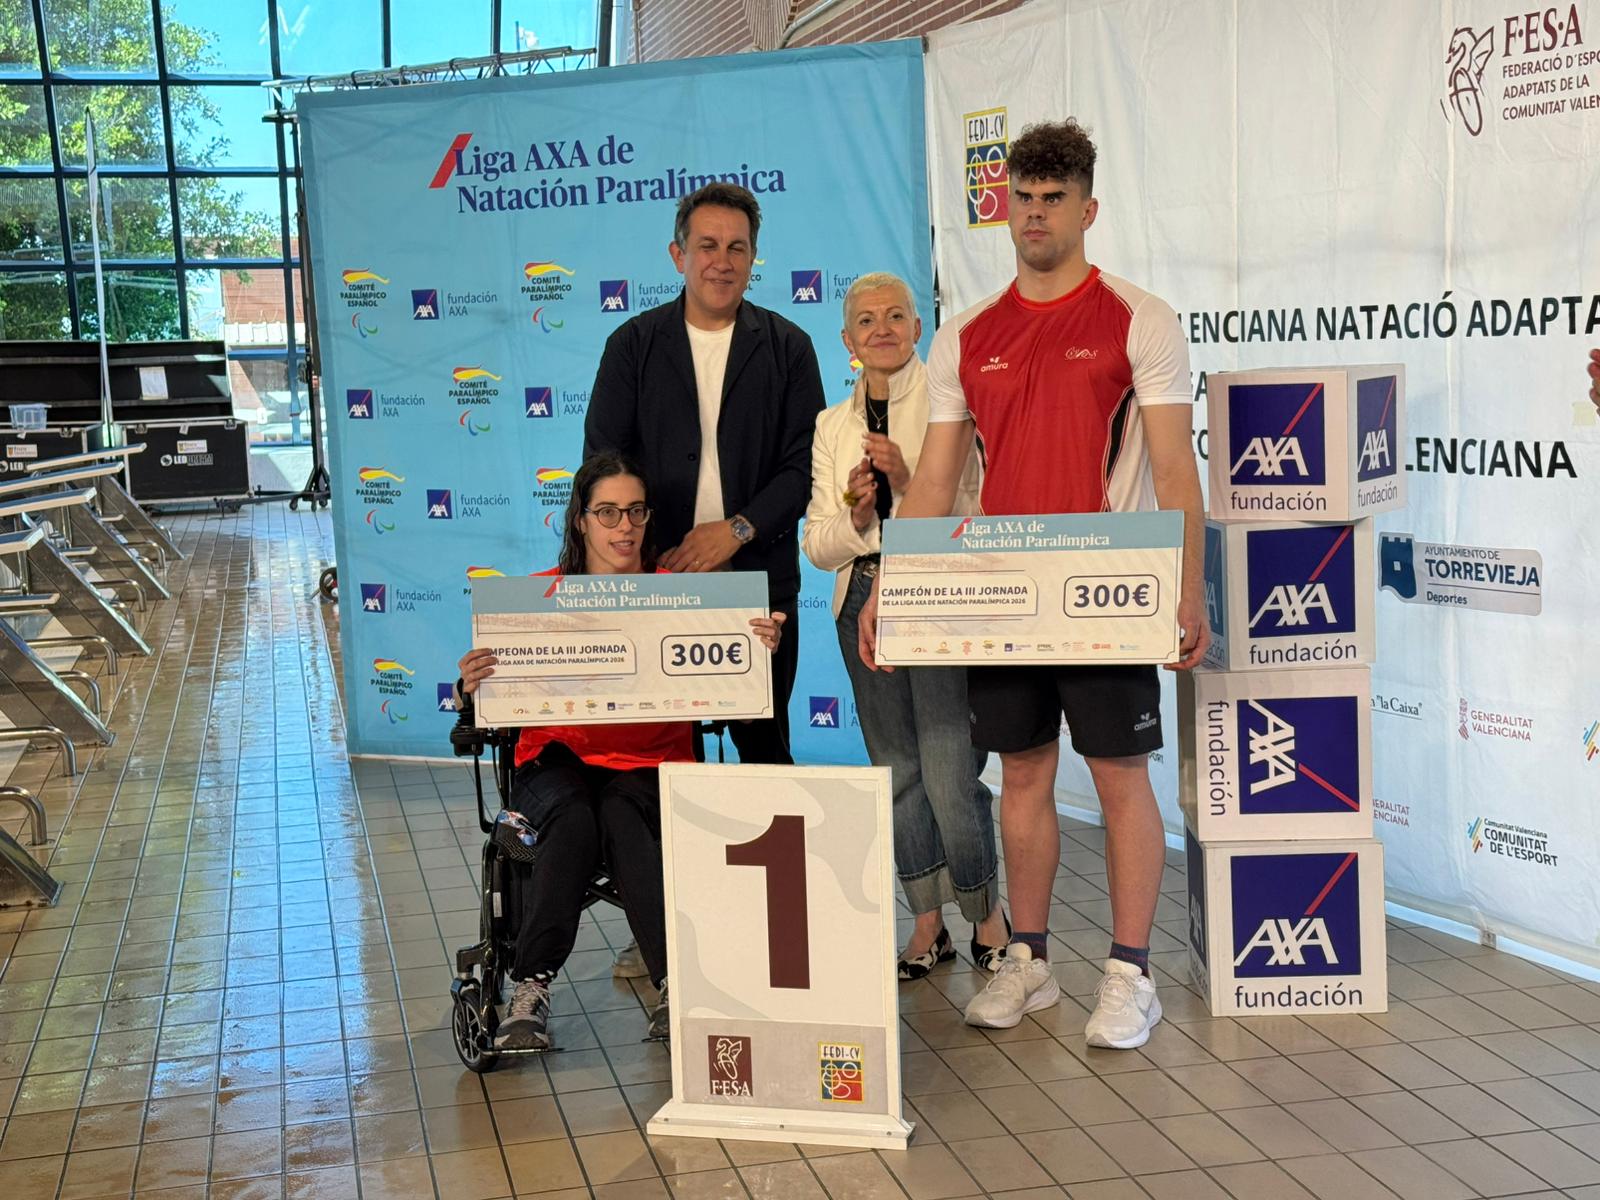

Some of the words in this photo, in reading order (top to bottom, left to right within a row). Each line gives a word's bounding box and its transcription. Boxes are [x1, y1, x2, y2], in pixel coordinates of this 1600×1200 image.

[1502, 53, 1562, 78] FEDERACIÓ
[1502, 80, 1556, 100] ADAPTATS
[1560, 76, 1573, 91] DE
[1576, 74, 1590, 88] LA
[1502, 99, 1566, 120] COMUNITAT
[454, 146, 516, 181] Liga
[525, 139, 589, 171] AXA
[597, 135, 634, 166] de
[458, 177, 588, 213] Natación
[639, 282, 685, 295] fundaci
[792, 287, 817, 301] AXA
[447, 291, 498, 305] fundación
[601, 296, 624, 310] AXA
[640, 296, 660, 308] AXA
[414, 304, 435, 317] AXA
[449, 304, 468, 317] AXA
[1178, 307, 1306, 344] ENCIANA
[1316, 291, 1457, 341] NATACIÓ
[980, 363, 1009, 372] amura
[381, 394, 425, 407] fundación
[526, 402, 549, 416] AXA
[349, 404, 369, 417] AXA
[383, 407, 399, 417] AXA
[563, 404, 584, 415] AXA
[1230, 437, 1310, 476] AXA
[1358, 429, 1391, 472] AXA
[1405, 436, 1578, 478] ENCIANA
[460, 494, 511, 507] fundación
[1231, 491, 1327, 511] fundación
[1357, 481, 1398, 507] fundación
[428, 504, 448, 517] AXA
[462, 507, 481, 518] AXA
[962, 521, 991, 537] Liga
[994, 521, 1024, 534] AXA
[1027, 520, 1045, 533] de
[961, 536, 1022, 549] Natación
[1025, 533, 1110, 548] Paralímpica
[1425, 546, 1487, 559] AYUNTAMIENTO
[1488, 550, 1500, 560] DE
[1424, 558, 1540, 587] TORREVIEJA
[396, 588, 442, 601] fundación
[555, 580, 584, 596] Liga
[587, 580, 617, 593] AXA
[620, 579, 637, 592] de
[881, 585, 931, 597] CAMPEÓN
[934, 587, 947, 596] DE
[950, 587, 962, 596] LA
[965, 587, 976, 595] III
[978, 586, 1028, 596] JORNADA
[1073, 583, 1151, 609] 300€
[363, 598, 381, 610] AXA
[397, 601, 415, 611] AXA
[555, 594, 616, 609] Natación
[620, 593, 701, 608] Paralímpica
[1249, 582, 1337, 628] AXA
[1427, 591, 1467, 605] Deportes
[489, 646, 533, 657] MPEONA
[536, 646, 550, 656] DE
[551, 646, 564, 655] LA
[566, 645, 576, 654] III
[579, 644, 627, 654] JORNADA
[670, 641, 744, 667] 300€
[1250, 639, 1356, 665] fundación
[536, 656, 566, 665] NATACIÓN
[568, 656, 609, 664] PARALÍMPICA
[810, 712, 834, 725] AXA
[1134, 718, 1157, 731] amura
[1471, 710, 1533, 729] GENERALITAT
[1472, 722, 1532, 741] VALENCIANA
[1248, 700, 1296, 795] AXA
[1208, 700, 1232, 816] fundación
[1373, 810, 1410, 827] ENCIANA
[1484, 818, 1514, 832] Comunitat
[1515, 825, 1548, 839] Valenciana
[1484, 827, 1548, 852] COMUNITAT
[1490, 841, 1504, 855] DE
[1507, 844, 1558, 867] L'ESPORT
[725, 815, 811, 990] 1
[1234, 917, 1339, 966] AXA
[1234, 981, 1362, 1008] fundación
